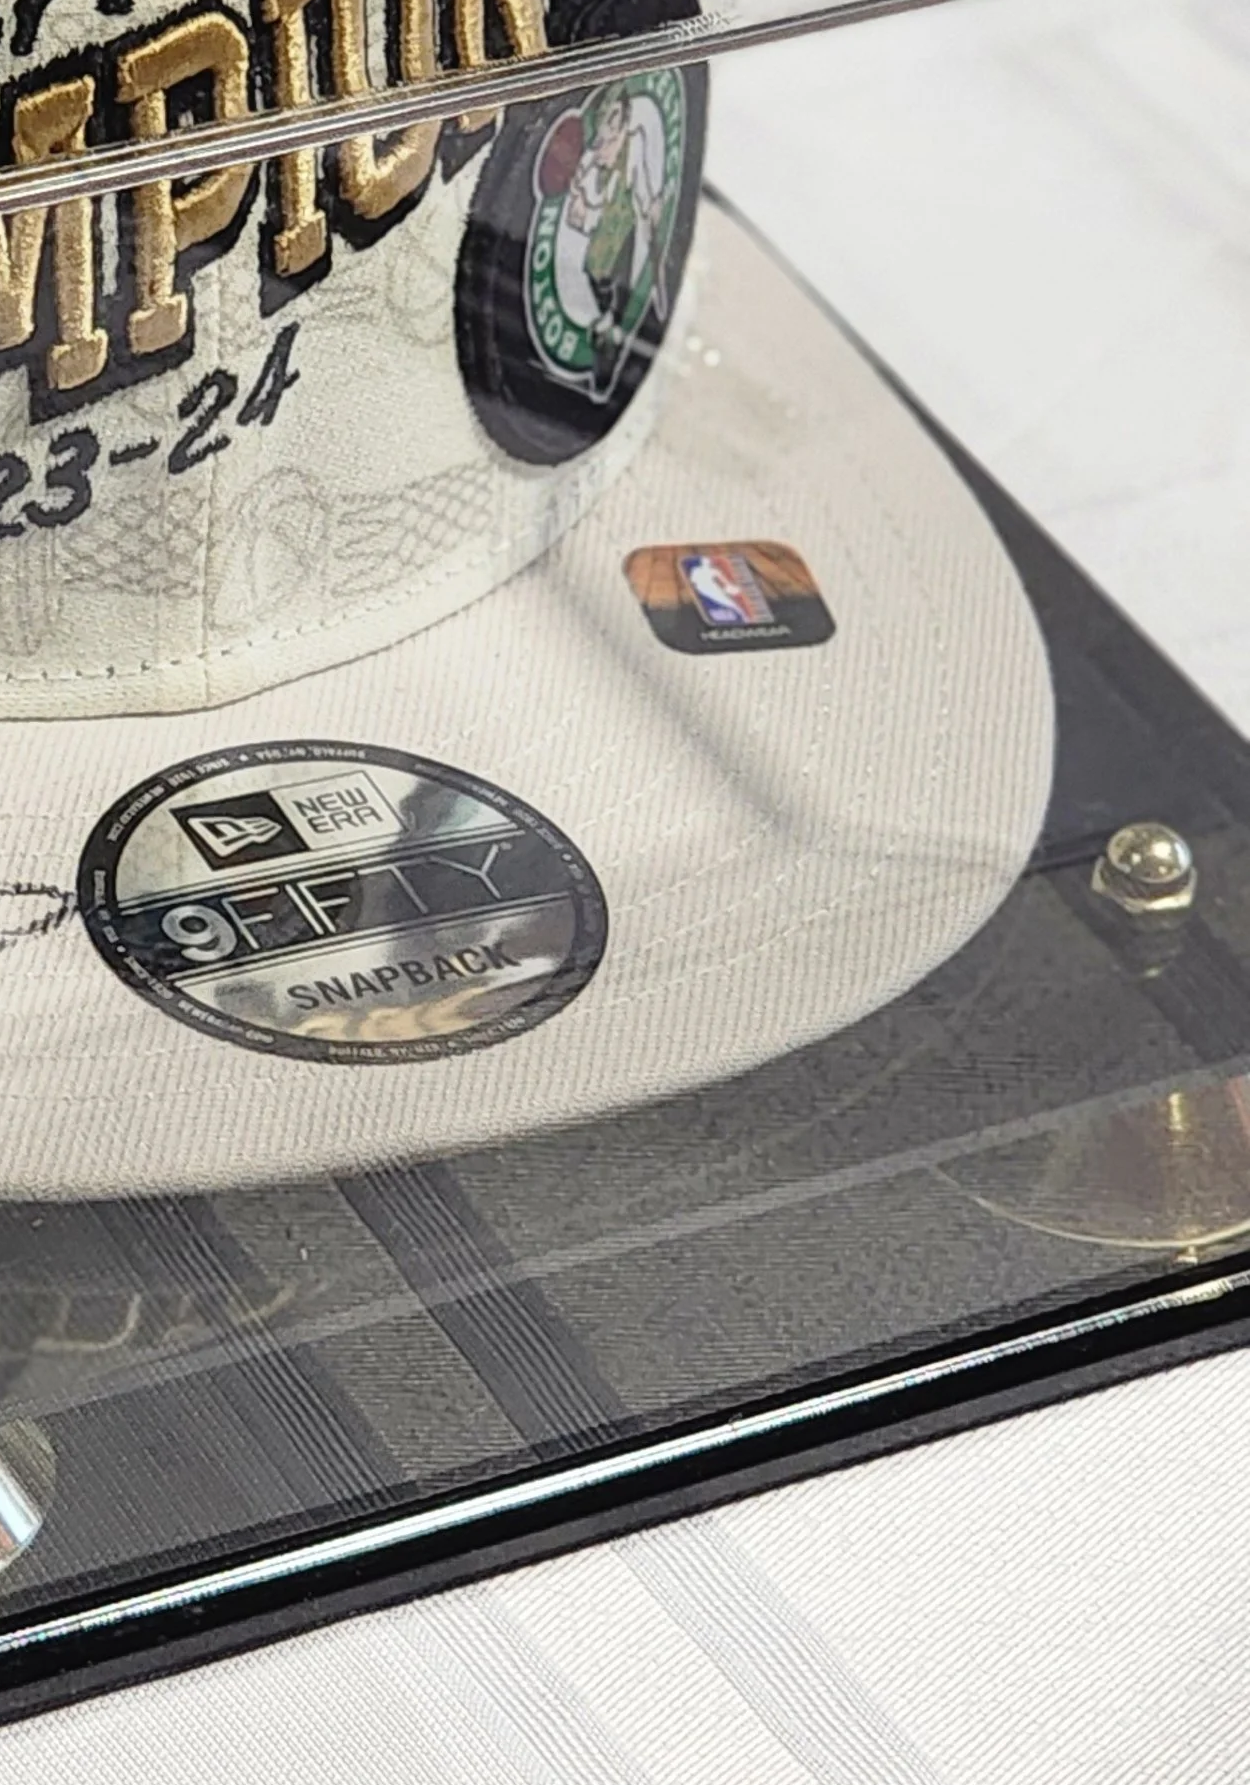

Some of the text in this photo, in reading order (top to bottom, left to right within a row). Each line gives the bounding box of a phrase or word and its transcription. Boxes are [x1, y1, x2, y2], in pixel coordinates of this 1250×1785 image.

[531, 206, 579, 362] BOSTON
[291, 786, 371, 818] NEW
[306, 807, 384, 835] ERA
[160, 842, 505, 963] 9FIFTY
[286, 941, 522, 1011] SNAPBACK
